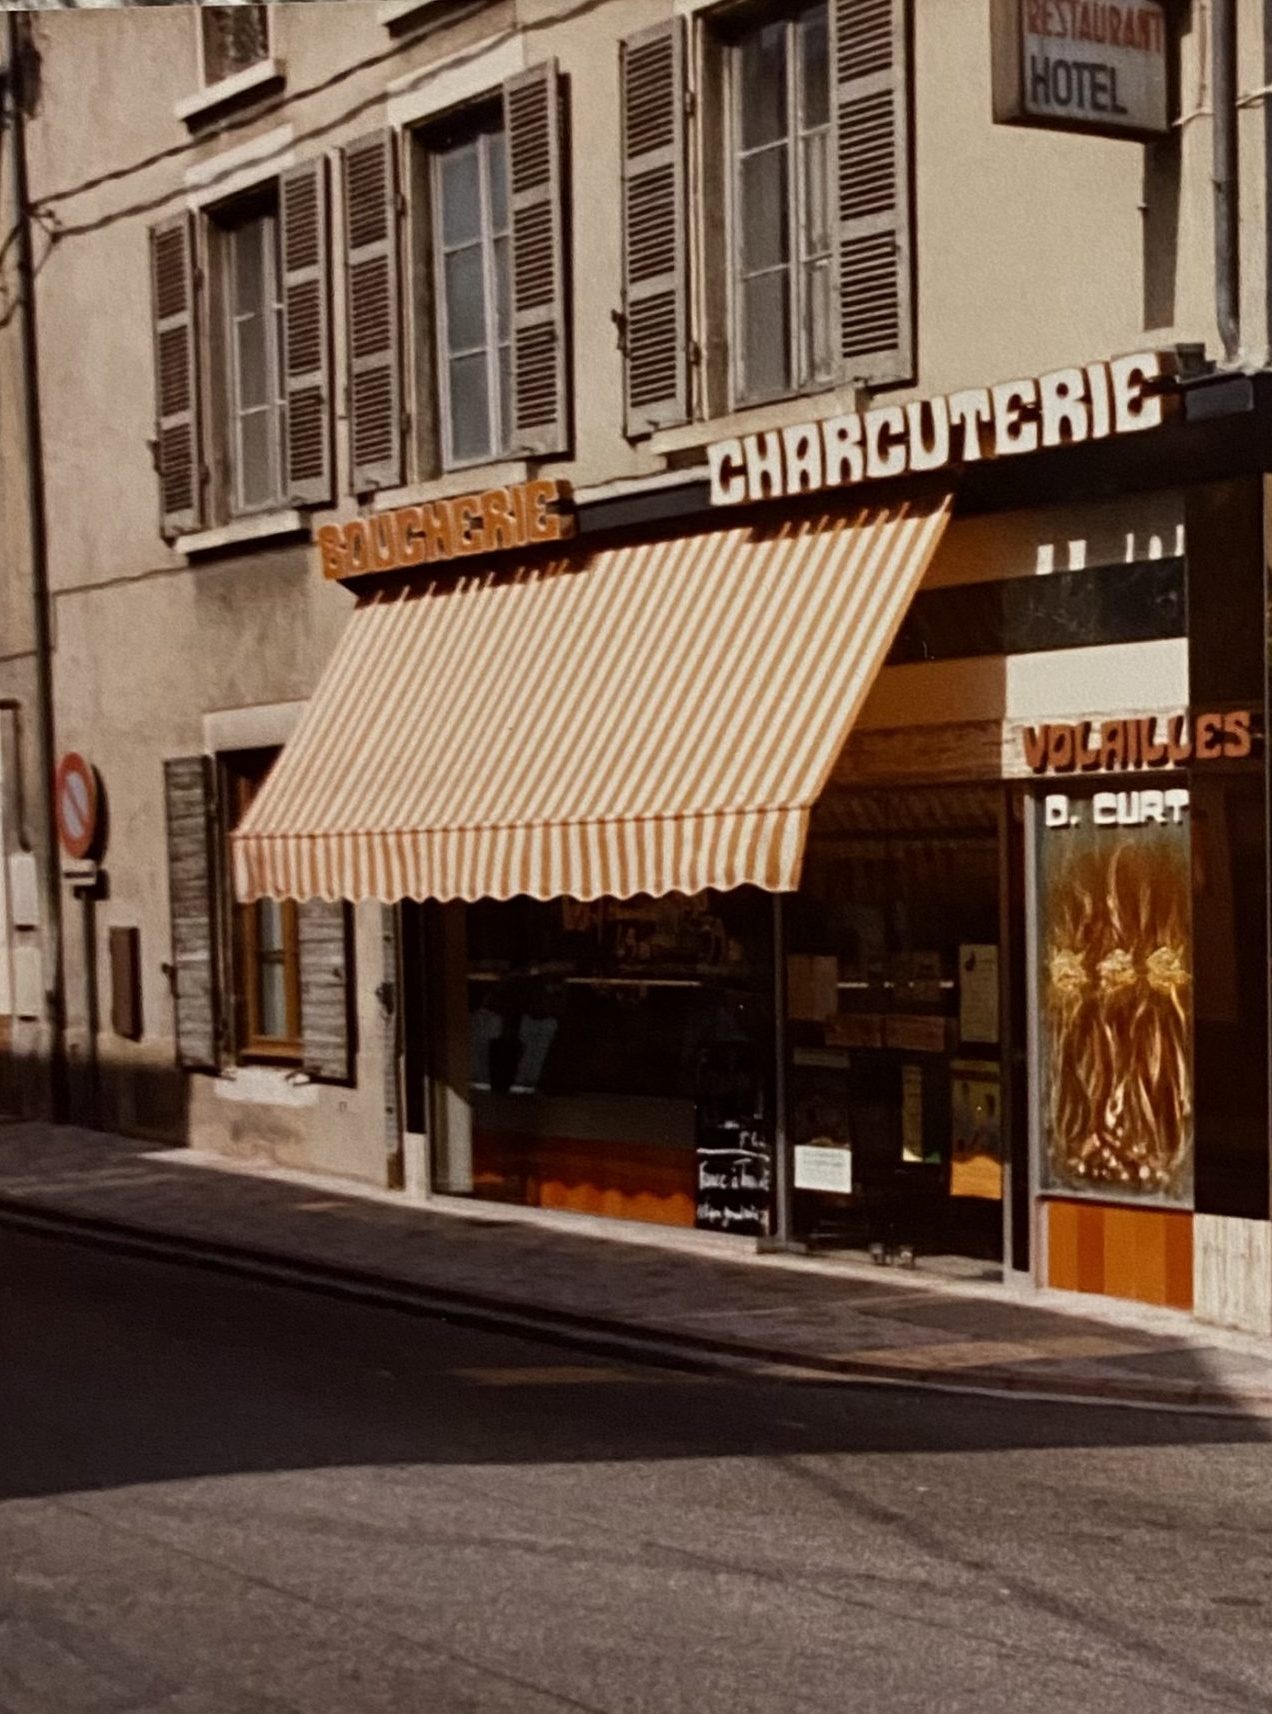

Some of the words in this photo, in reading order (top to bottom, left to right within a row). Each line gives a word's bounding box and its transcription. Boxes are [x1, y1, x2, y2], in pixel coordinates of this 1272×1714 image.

[1031, 54, 1128, 115] HOTEL
[708, 351, 1164, 508] CHARCUTERIE
[316, 479, 565, 580] BOUCHERIE
[1022, 710, 1250, 774] VOLAILLES
[1092, 788, 1190, 826] CURT
